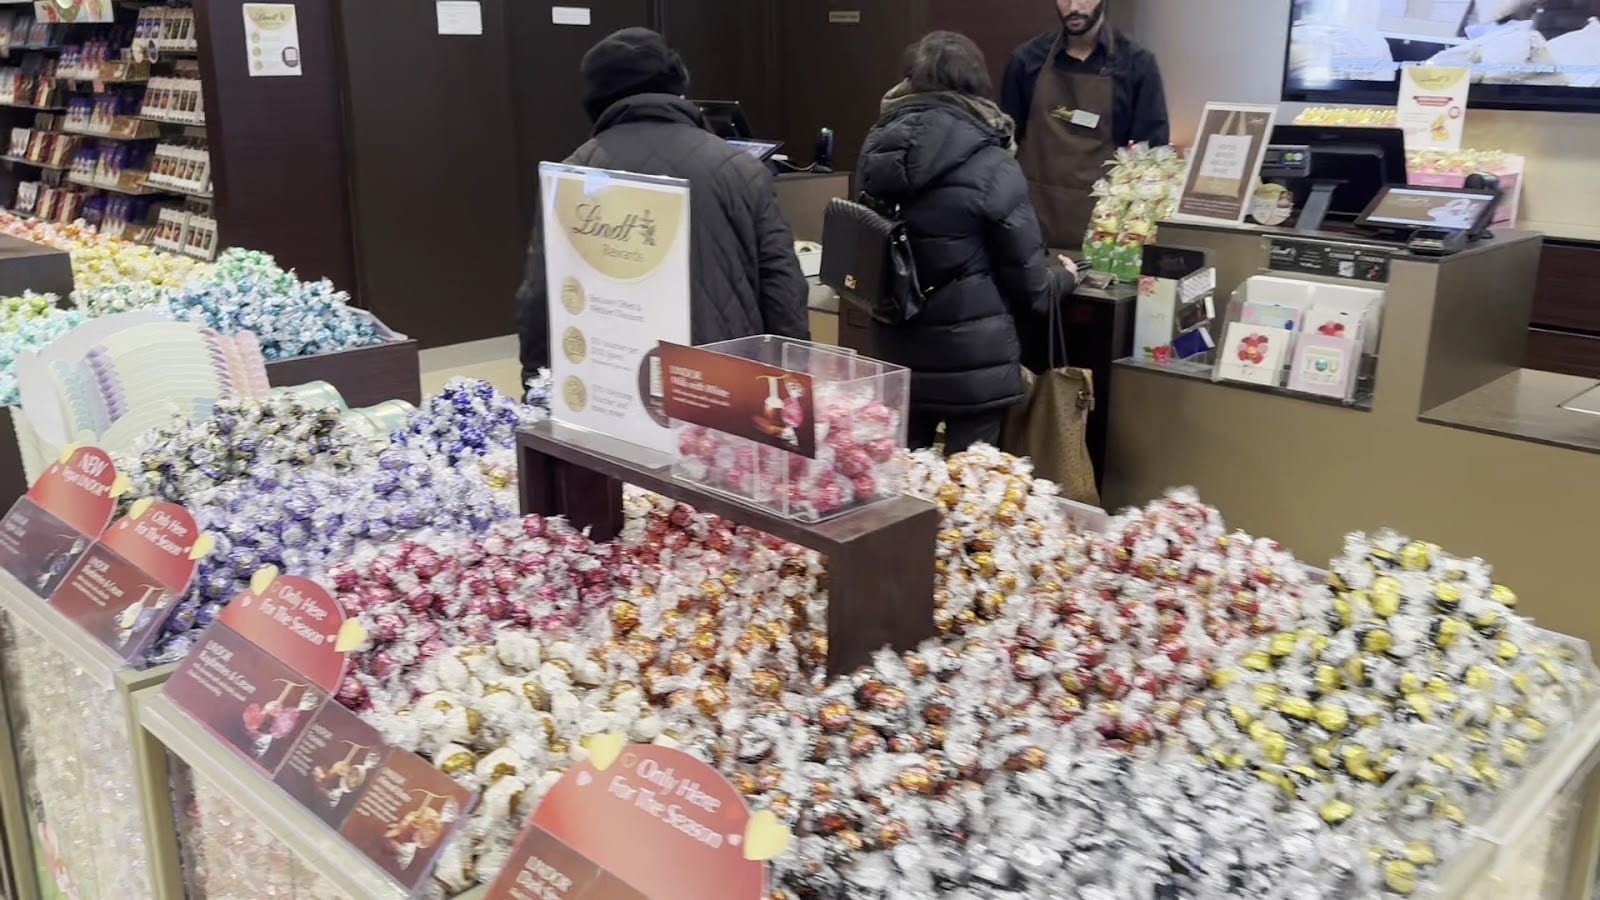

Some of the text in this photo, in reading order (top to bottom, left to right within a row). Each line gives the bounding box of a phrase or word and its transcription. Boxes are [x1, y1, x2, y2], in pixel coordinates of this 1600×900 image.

[572, 203, 641, 242] Lindt
[78, 454, 109, 477] NEW
[157, 534, 183, 556] Season
[168, 517, 188, 537] Here
[278, 585, 328, 621] Only Here
[259, 598, 325, 646] For The Season
[637, 759, 721, 813] Only Here
[607, 775, 723, 849] For The Season
